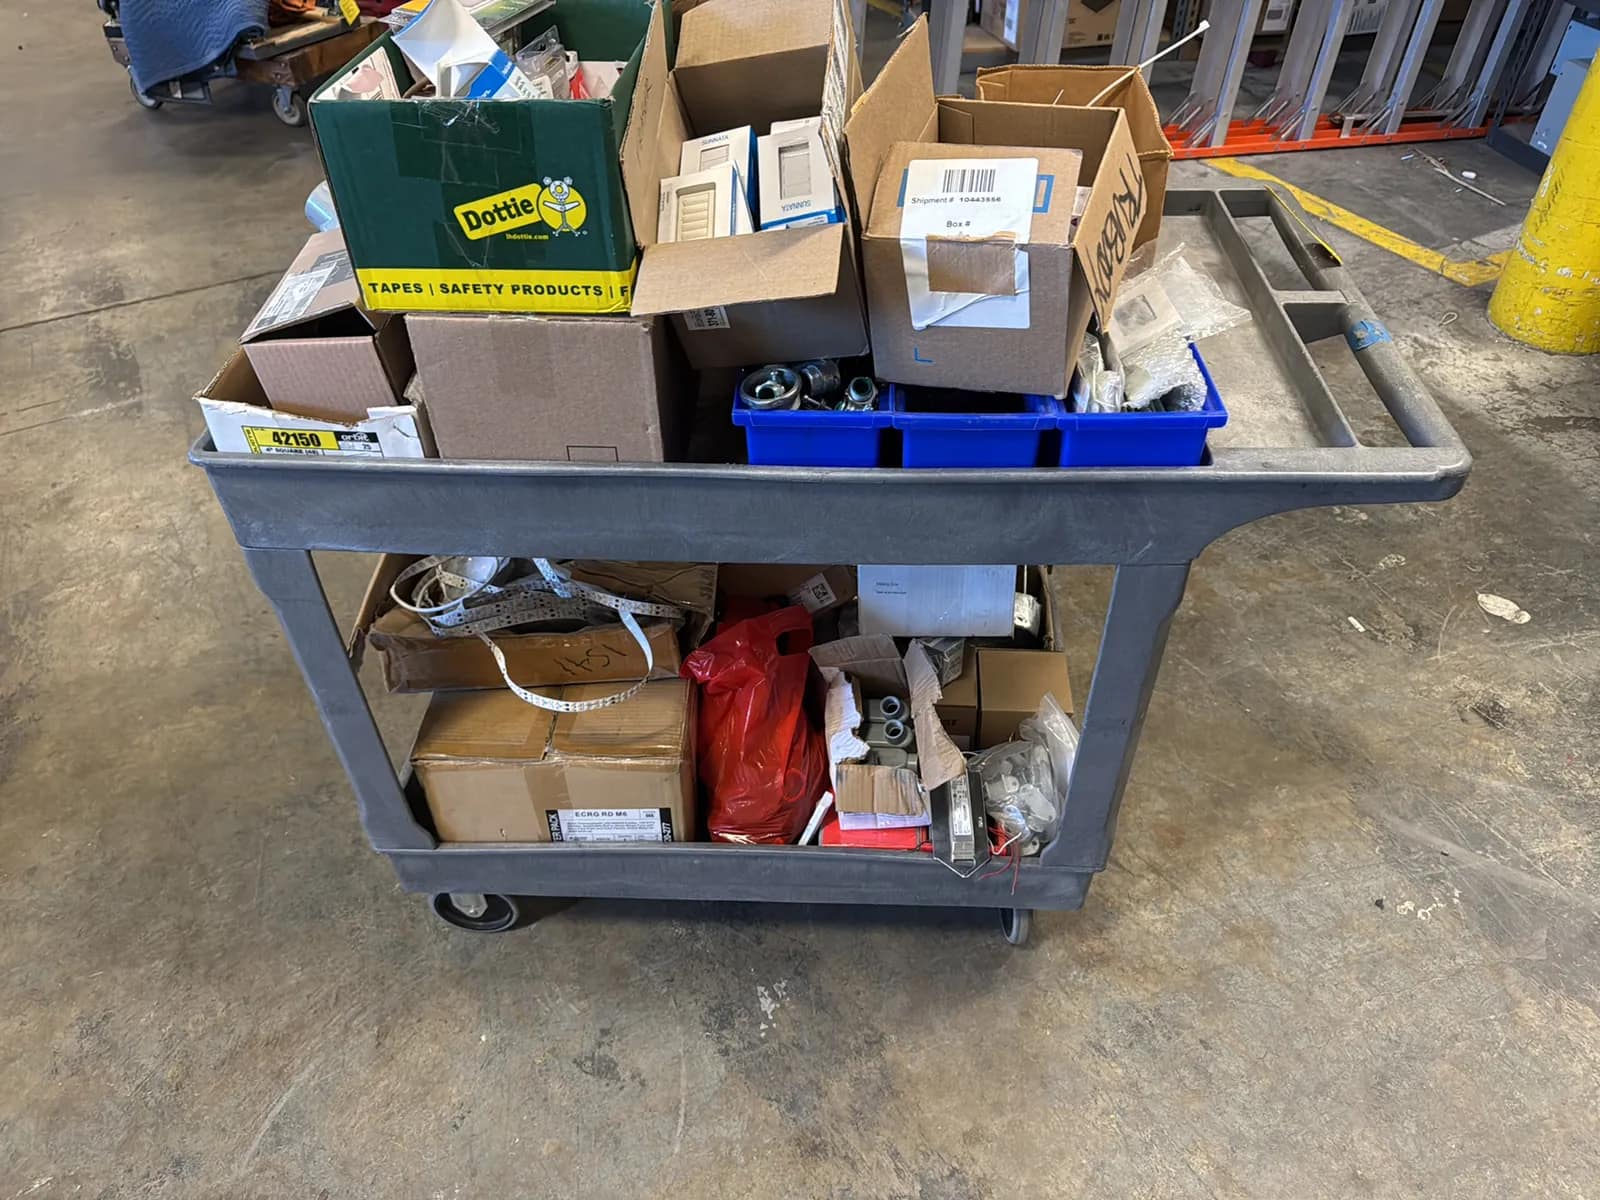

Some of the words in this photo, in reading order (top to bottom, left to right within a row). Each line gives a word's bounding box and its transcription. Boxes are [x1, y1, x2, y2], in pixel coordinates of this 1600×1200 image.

[461, 197, 535, 232] Dottie
[946, 220, 963, 228] Box
[369, 283, 423, 294] TAPES
[440, 283, 504, 295] SAFETY
[511, 284, 603, 297] PRODUCTS
[272, 431, 322, 447] 42150
